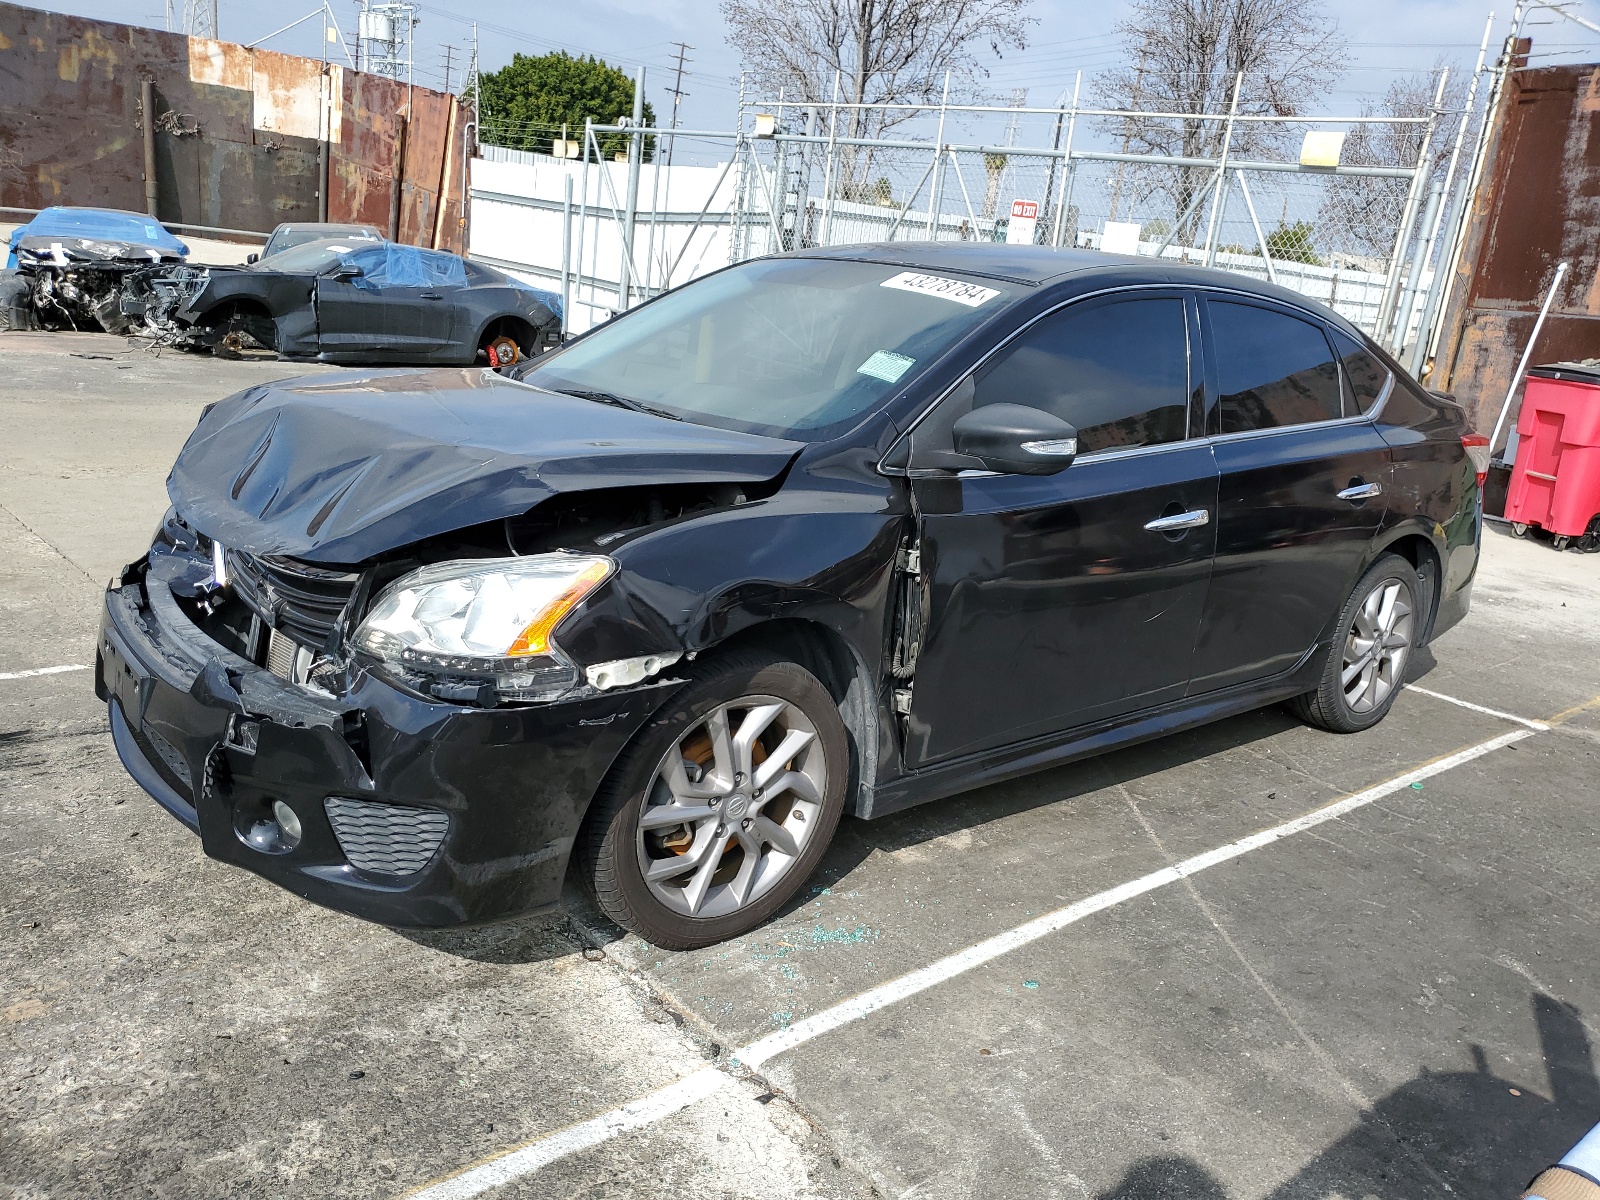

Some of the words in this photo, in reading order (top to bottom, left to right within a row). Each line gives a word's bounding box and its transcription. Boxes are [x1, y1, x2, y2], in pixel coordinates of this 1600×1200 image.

[1013, 204, 1022, 215] NO
[1022, 205, 1036, 217] EXIT
[903, 274, 986, 299] 43278784
